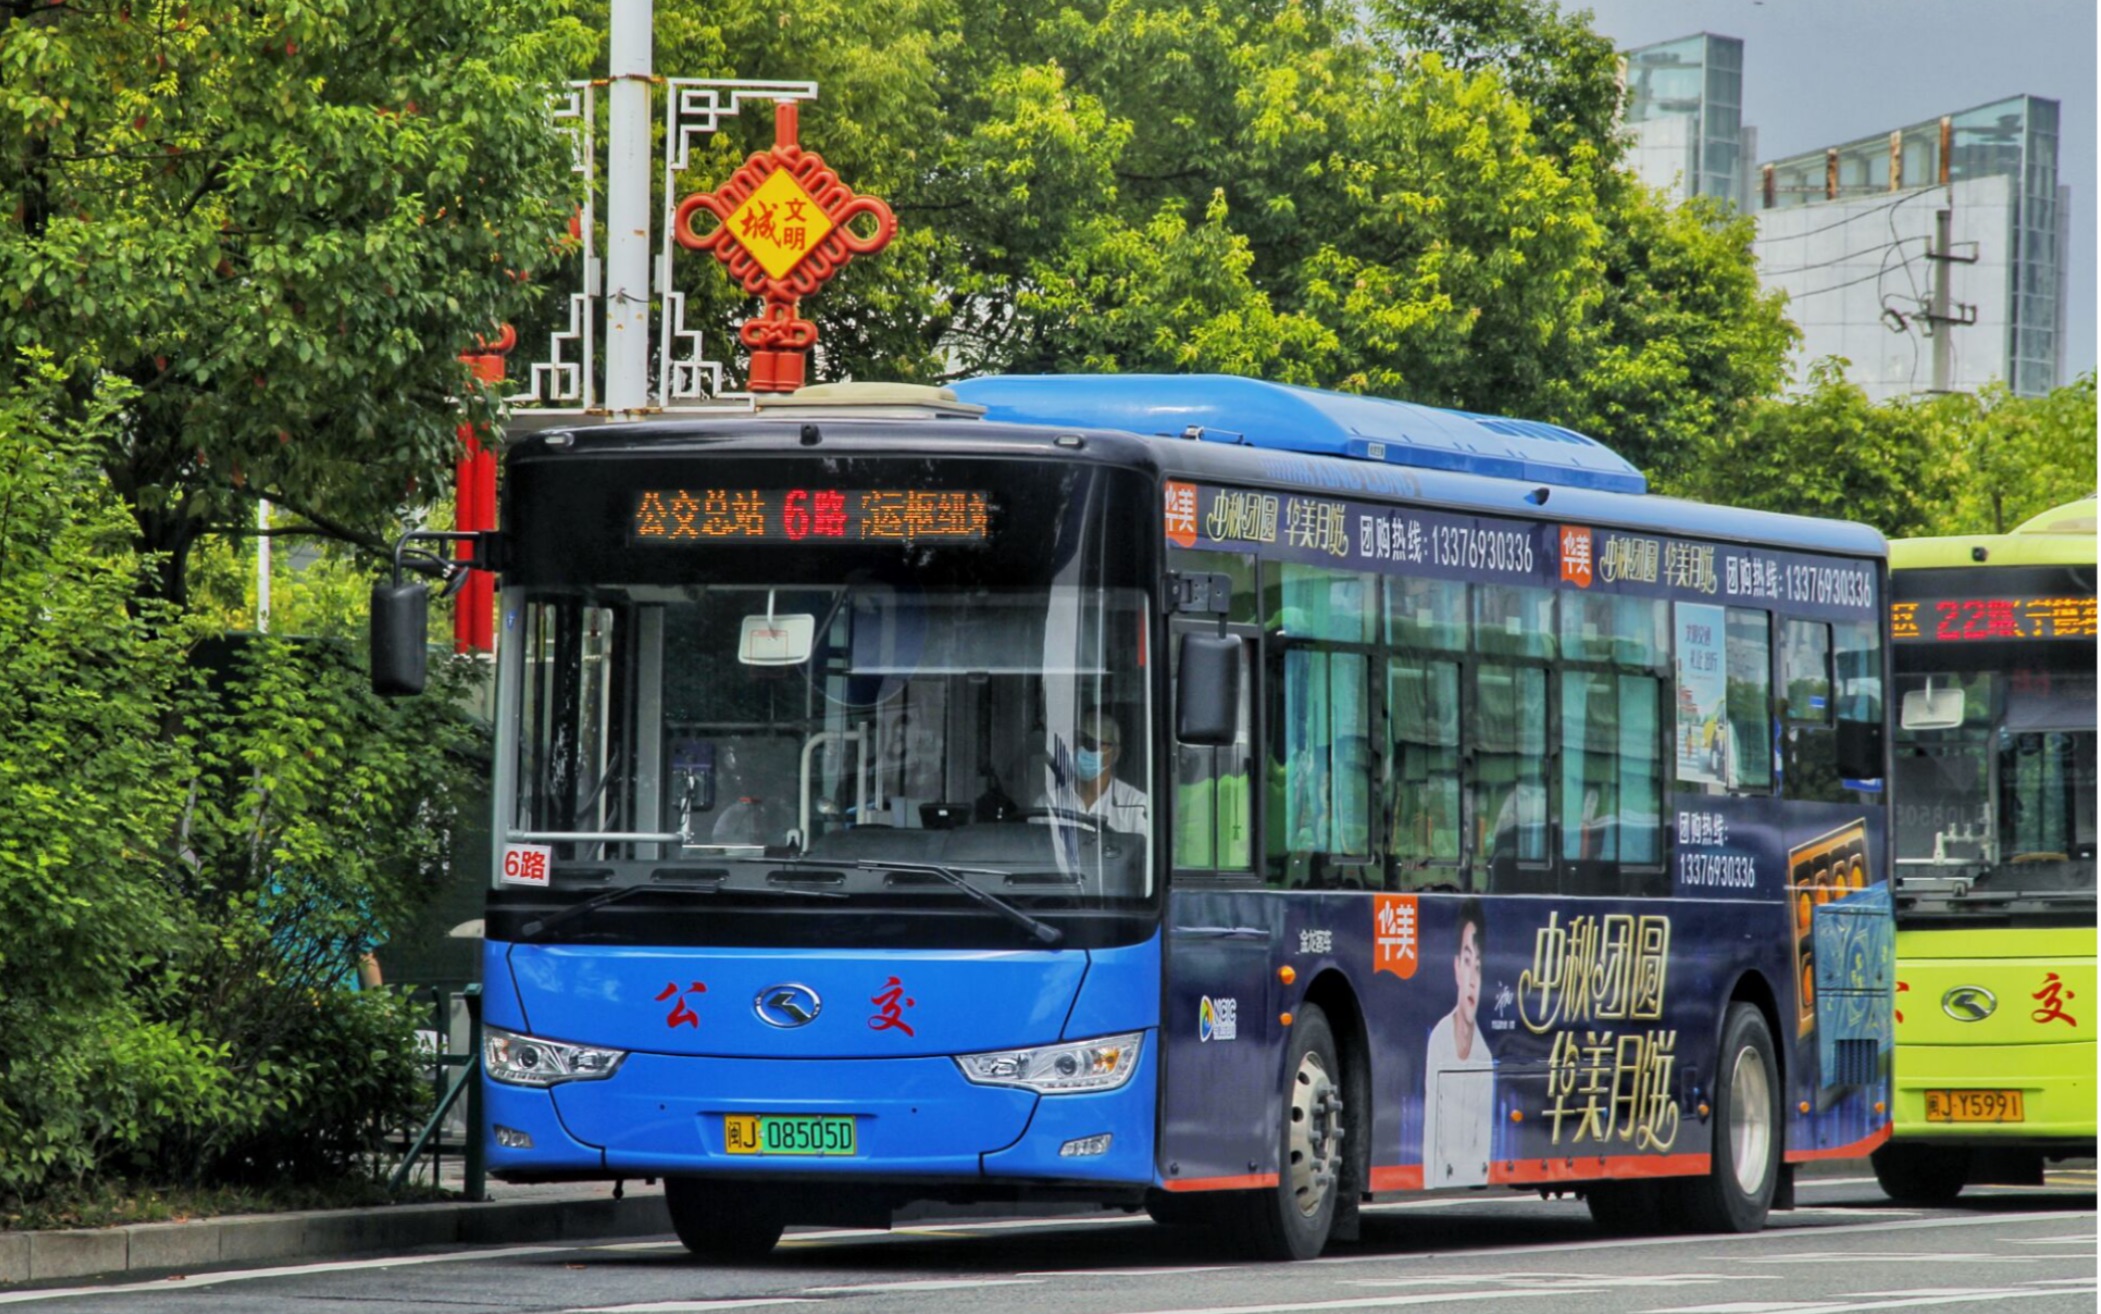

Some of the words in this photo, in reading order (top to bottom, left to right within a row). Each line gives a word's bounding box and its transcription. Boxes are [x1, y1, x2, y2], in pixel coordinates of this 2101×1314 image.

[784, 198, 806, 250] 文明
[636, 490, 765, 540] 公交总站
[783, 490, 847, 540] 6路
[861, 490, 987, 540] 运枢纽站
[1206, 488, 1279, 543] 中秋团圆
[1563, 531, 1591, 575] 华美
[1599, 534, 1658, 583] 中秋团圆
[504, 850, 546, 880] 6路
[1680, 853, 1755, 888] 13376930336
[1378, 900, 1415, 961] 华美
[1518, 911, 1670, 1034] 中秋团圆
[655, 981, 707, 1029] 公
[867, 975, 915, 1037] 交
[2030, 972, 2078, 1027] 交
[1542, 1030, 1679, 1152] 华美月饼
